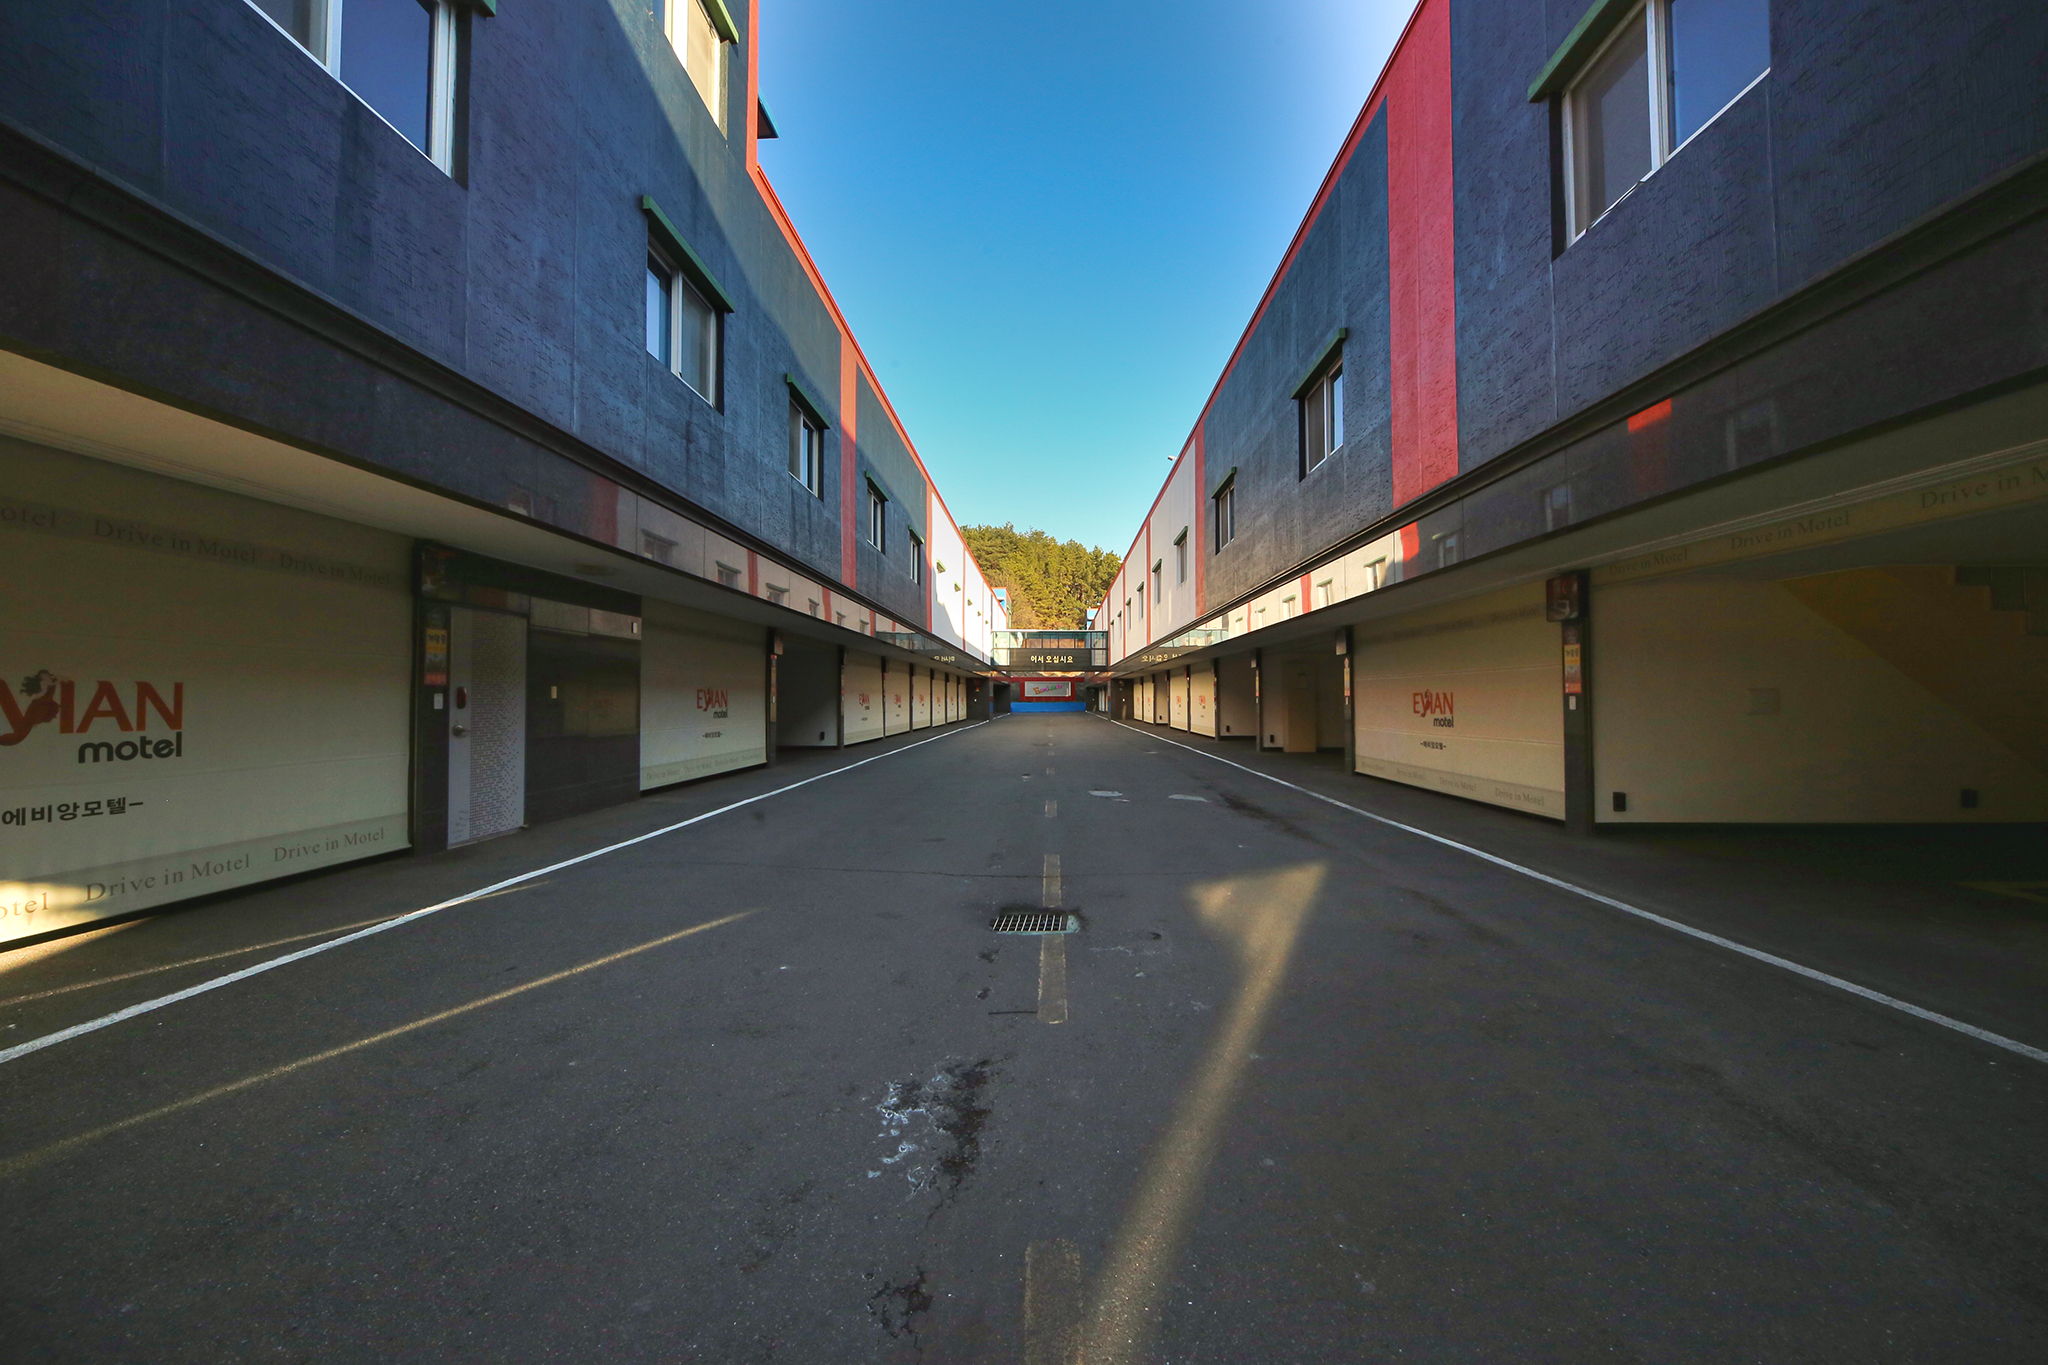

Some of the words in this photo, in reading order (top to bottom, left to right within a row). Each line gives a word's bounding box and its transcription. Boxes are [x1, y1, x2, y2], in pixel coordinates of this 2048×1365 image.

[1921, 483, 1987, 508] Drive
[1997, 474, 2020, 491] in
[94, 517, 163, 547] Drive
[171, 532, 191, 550] in
[197, 538, 256, 563] Motel
[1731, 533, 1773, 550] Drive
[1777, 528, 1792, 540] in
[1797, 511, 1849, 534] Motel
[279, 553, 326, 574] Drive
[331, 563, 345, 578] in
[350, 567, 390, 585] Motel
[1608, 563, 1637, 576] Drive
[1653, 548, 1688, 567] Motel
[1030, 655, 1044, 664] 어서
[1045, 655, 1074, 664] 오십시요
[1433, 715, 1454, 728] motel
[78, 731, 182, 763] motel
[273, 843, 320, 862] Drive
[325, 837, 340, 851] in
[343, 827, 384, 847] Motel
[86, 876, 156, 901] Drive
[164, 868, 184, 885] in
[190, 853, 250, 881] Motel
